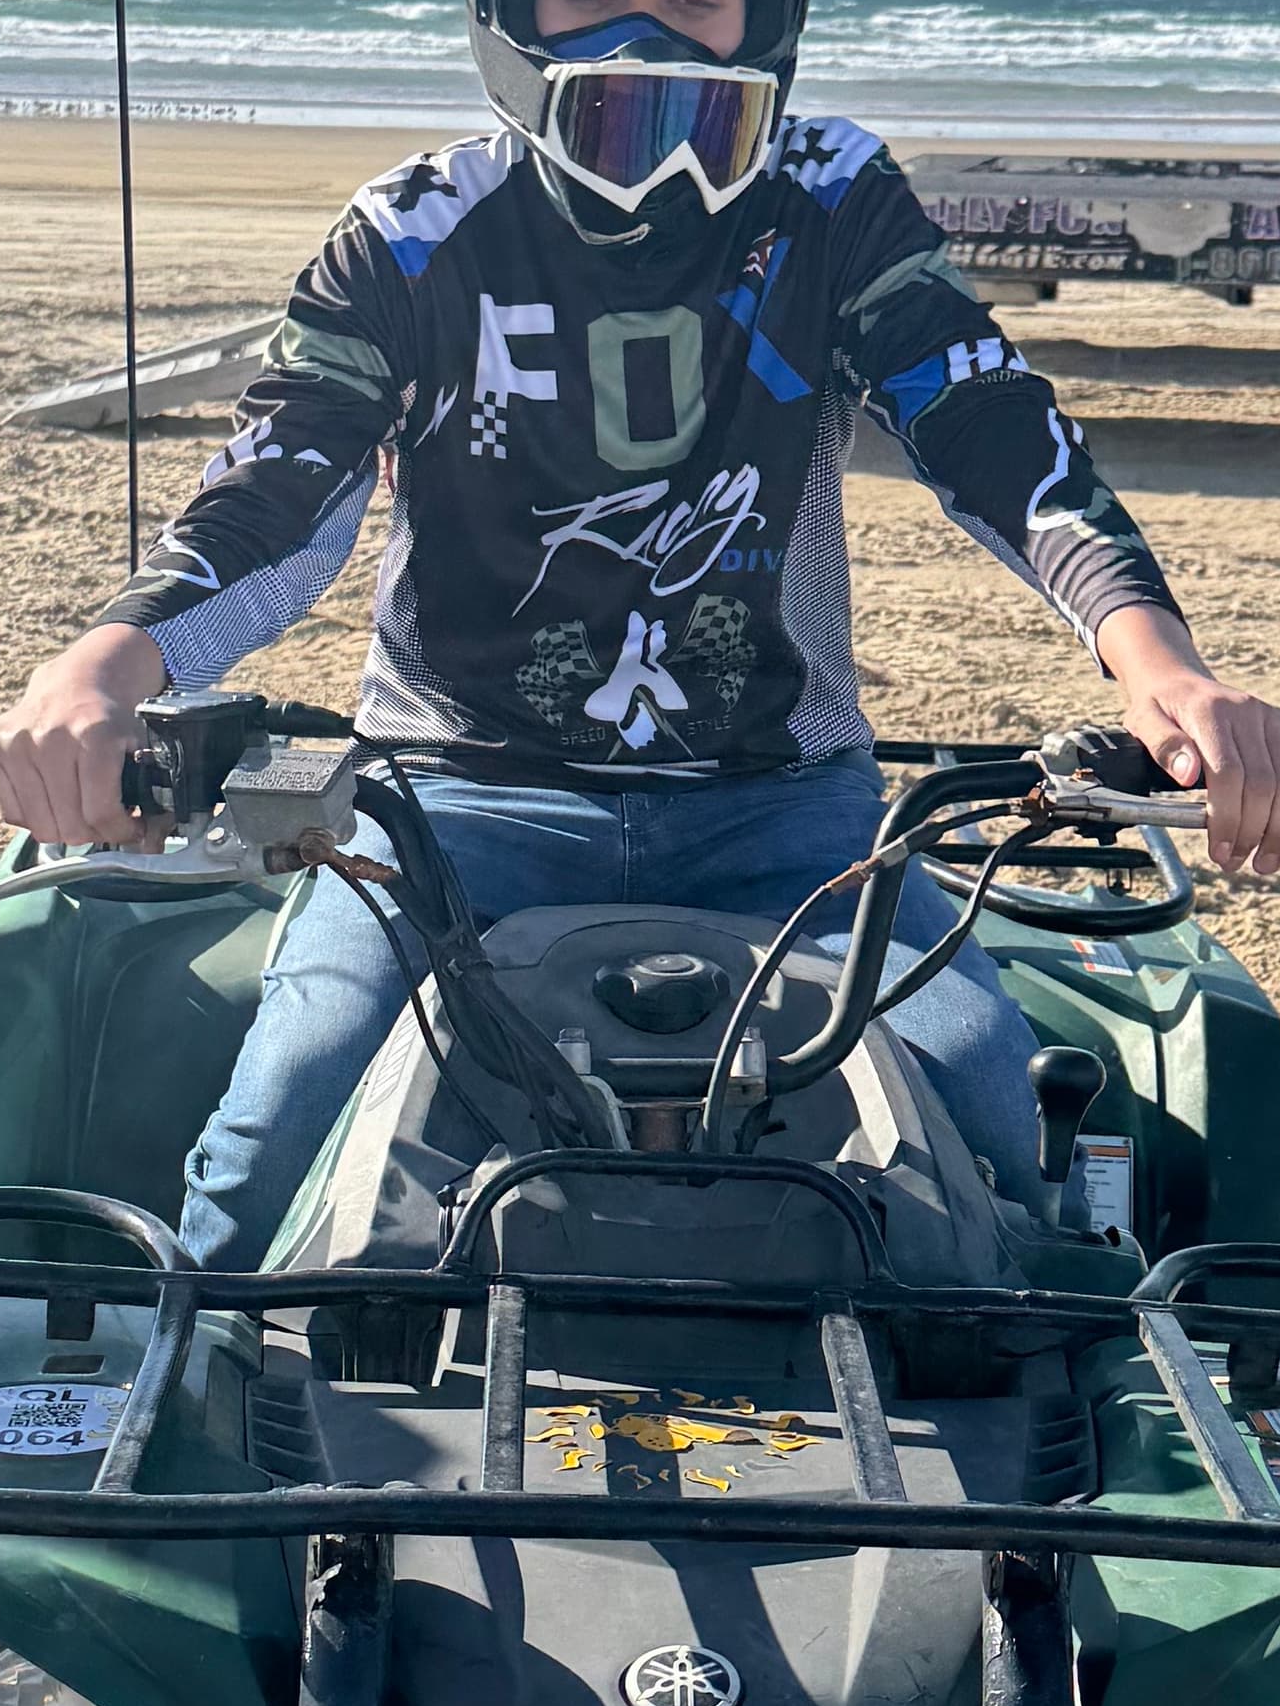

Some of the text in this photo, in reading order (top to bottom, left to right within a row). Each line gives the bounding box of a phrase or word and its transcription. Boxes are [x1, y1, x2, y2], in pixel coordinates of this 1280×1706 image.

[471, 236, 814, 470] FOX
[687, 715, 733, 736] STYLE
[560, 726, 607, 746] SPEED
[18, 1388, 89, 1403] QL
